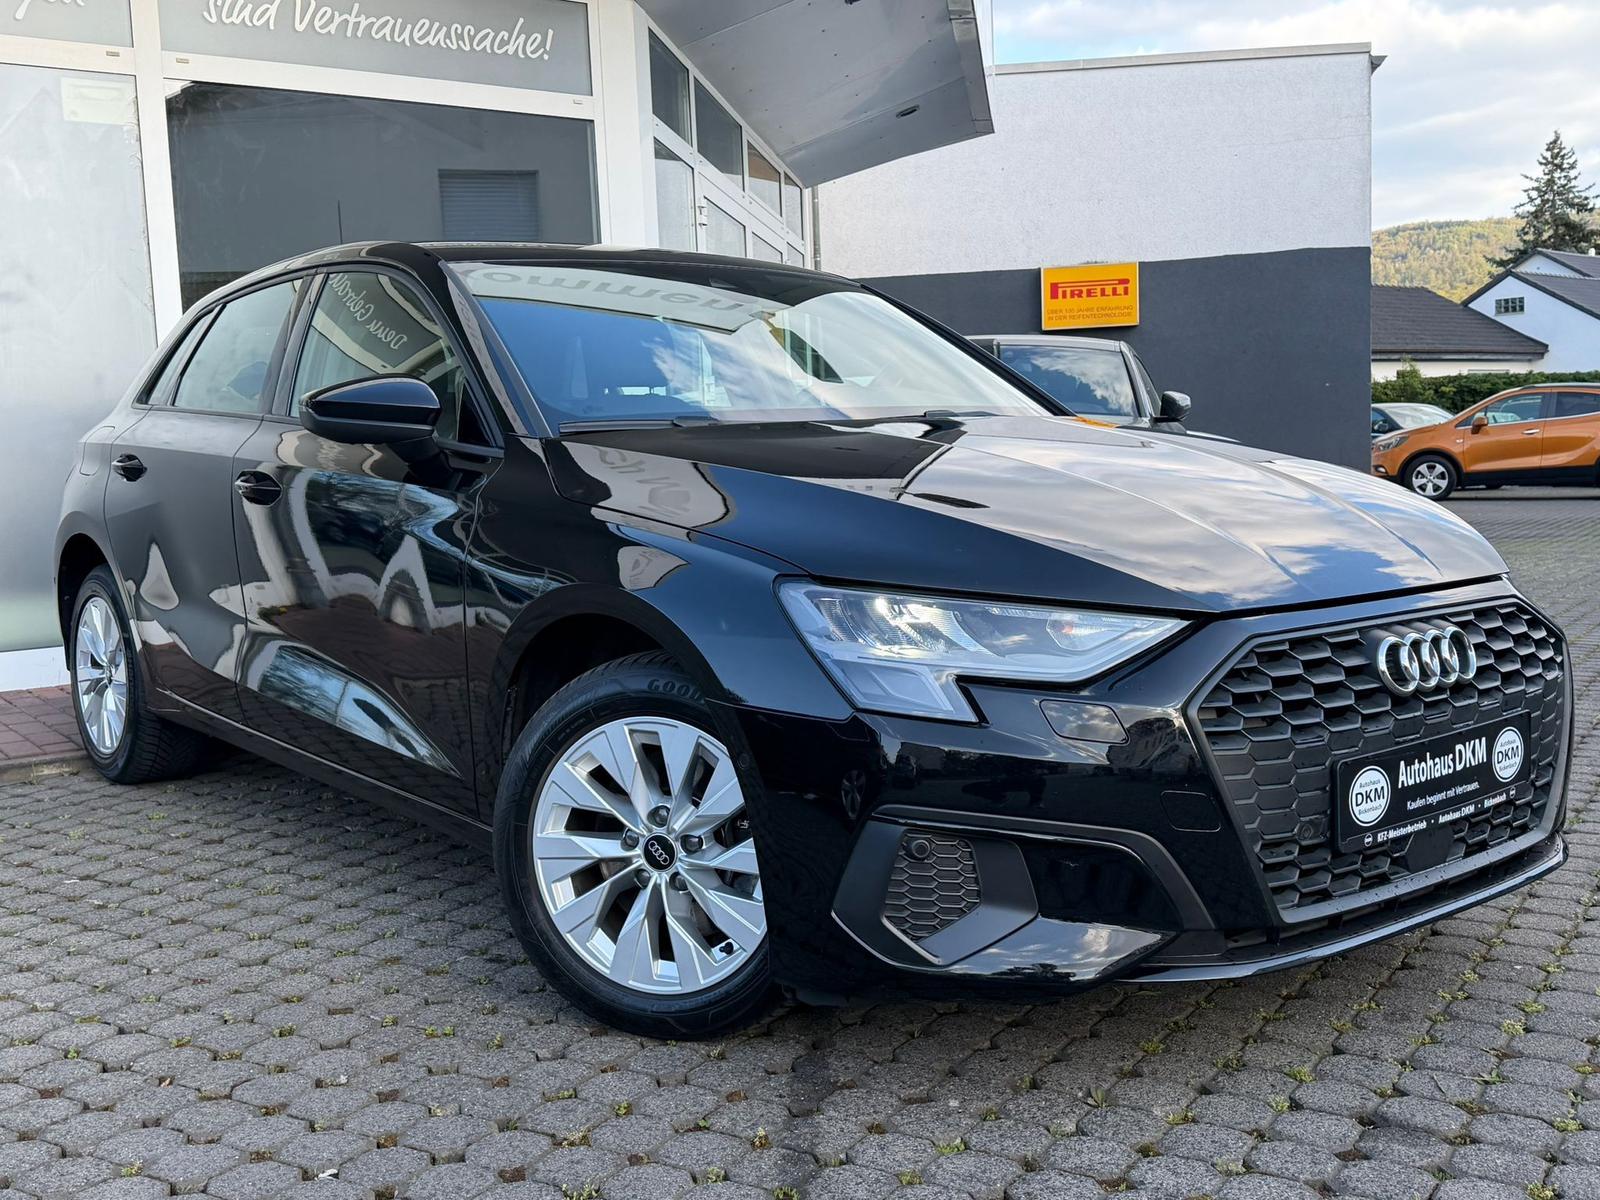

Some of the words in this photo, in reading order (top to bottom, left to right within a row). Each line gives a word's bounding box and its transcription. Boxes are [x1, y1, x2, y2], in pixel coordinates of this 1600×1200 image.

[202, 0, 280, 30] sind
[293, 0, 555, 60] Vertrauenssache!
[1050, 278, 1130, 299] PIRELLI
[1398, 752, 1454, 789] Autohaus
[1455, 737, 1487, 772] DKM
[1497, 744, 1520, 765] DKM
[1355, 785, 1386, 808] DKM
[1359, 779, 1381, 789] Autohaus
[1406, 797, 1426, 811] Kaufen
[1426, 790, 1447, 806] beginnt
[1447, 787, 1456, 799] mit
[1456, 781, 1480, 796] Vertrauen.
[1377, 820, 1427, 843] KFZ-Meisterbetrieb
[1438, 811, 1462, 824] Autohaus
[1462, 804, 1475, 817] DKM
